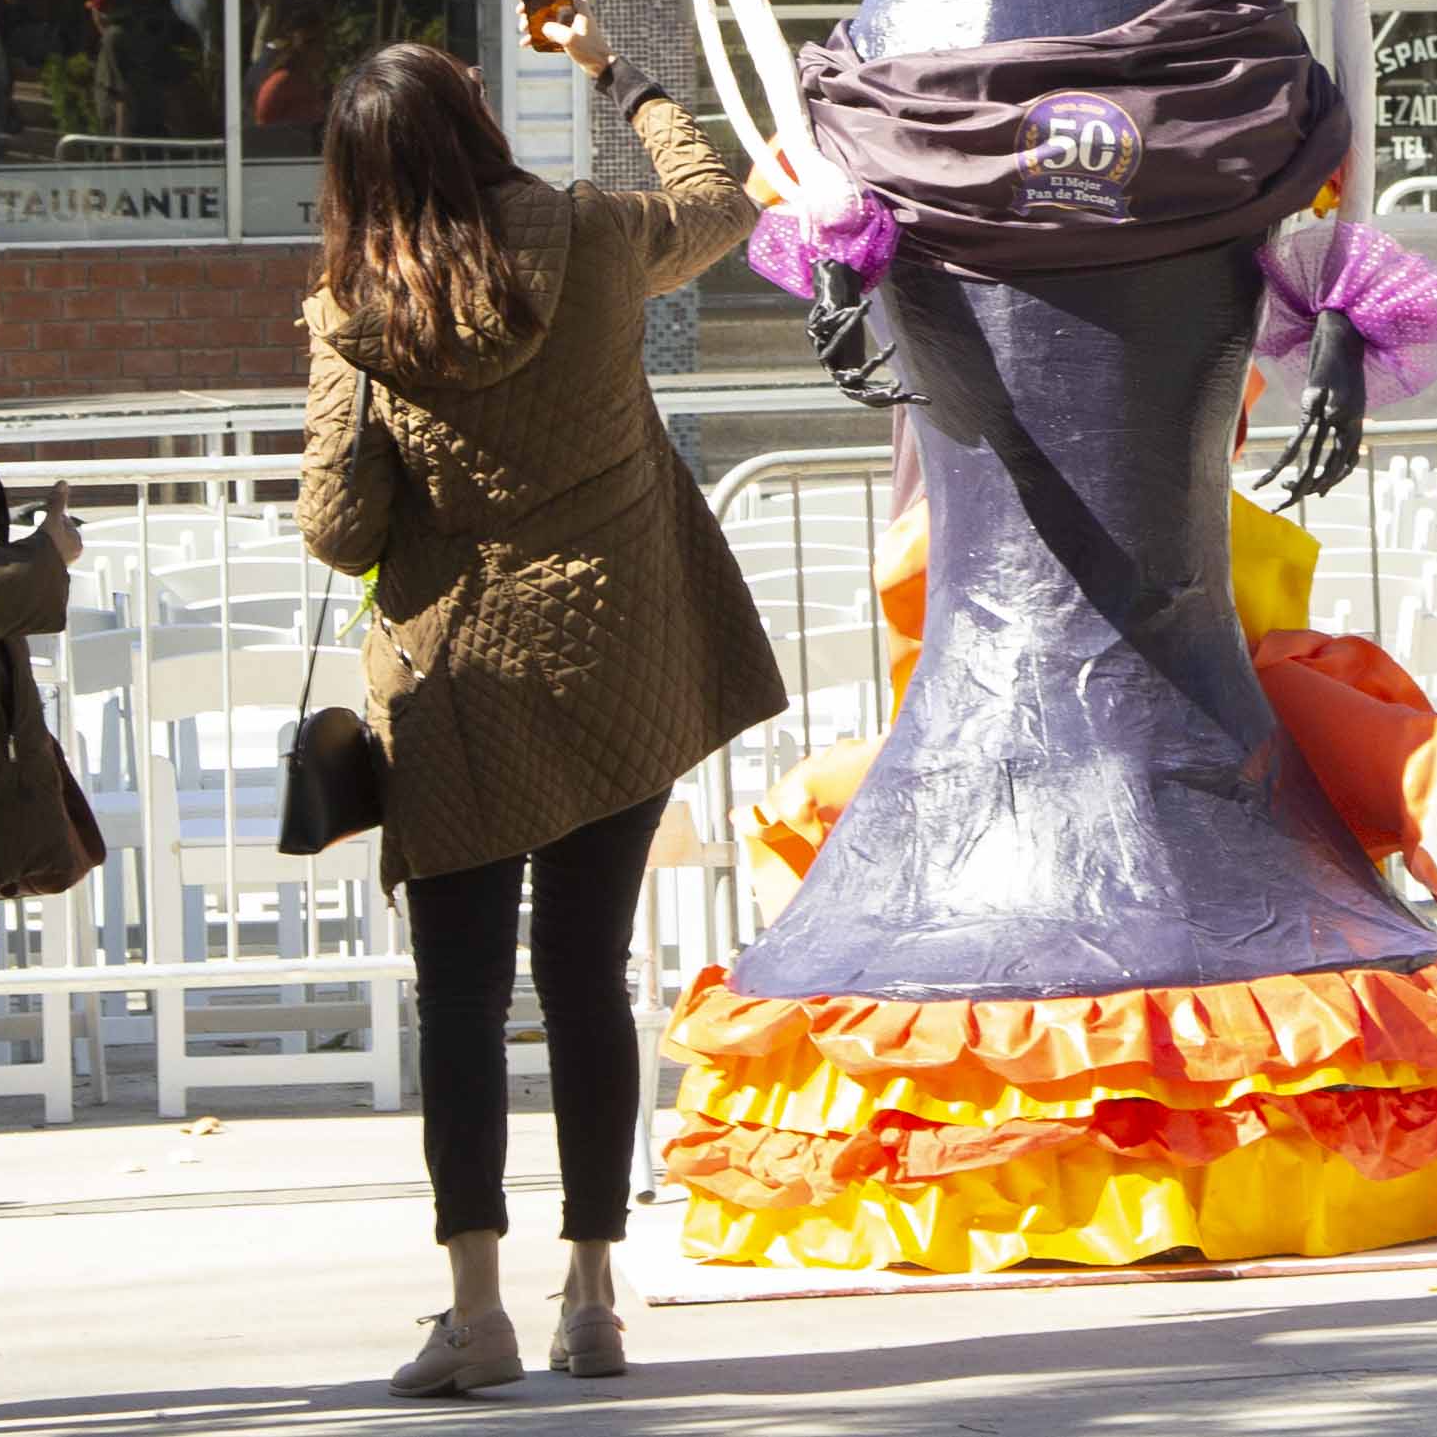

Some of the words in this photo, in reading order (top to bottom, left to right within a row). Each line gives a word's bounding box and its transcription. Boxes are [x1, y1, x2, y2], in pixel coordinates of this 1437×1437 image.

[1043, 117, 1116, 172] 50
[1050, 175, 1064, 187] El
[1066, 176, 1102, 193] Mejor
[1026, 188, 1053, 200] Pan
[1056, 188, 1073, 200] de
[1074, 188, 1117, 207] Tecate
